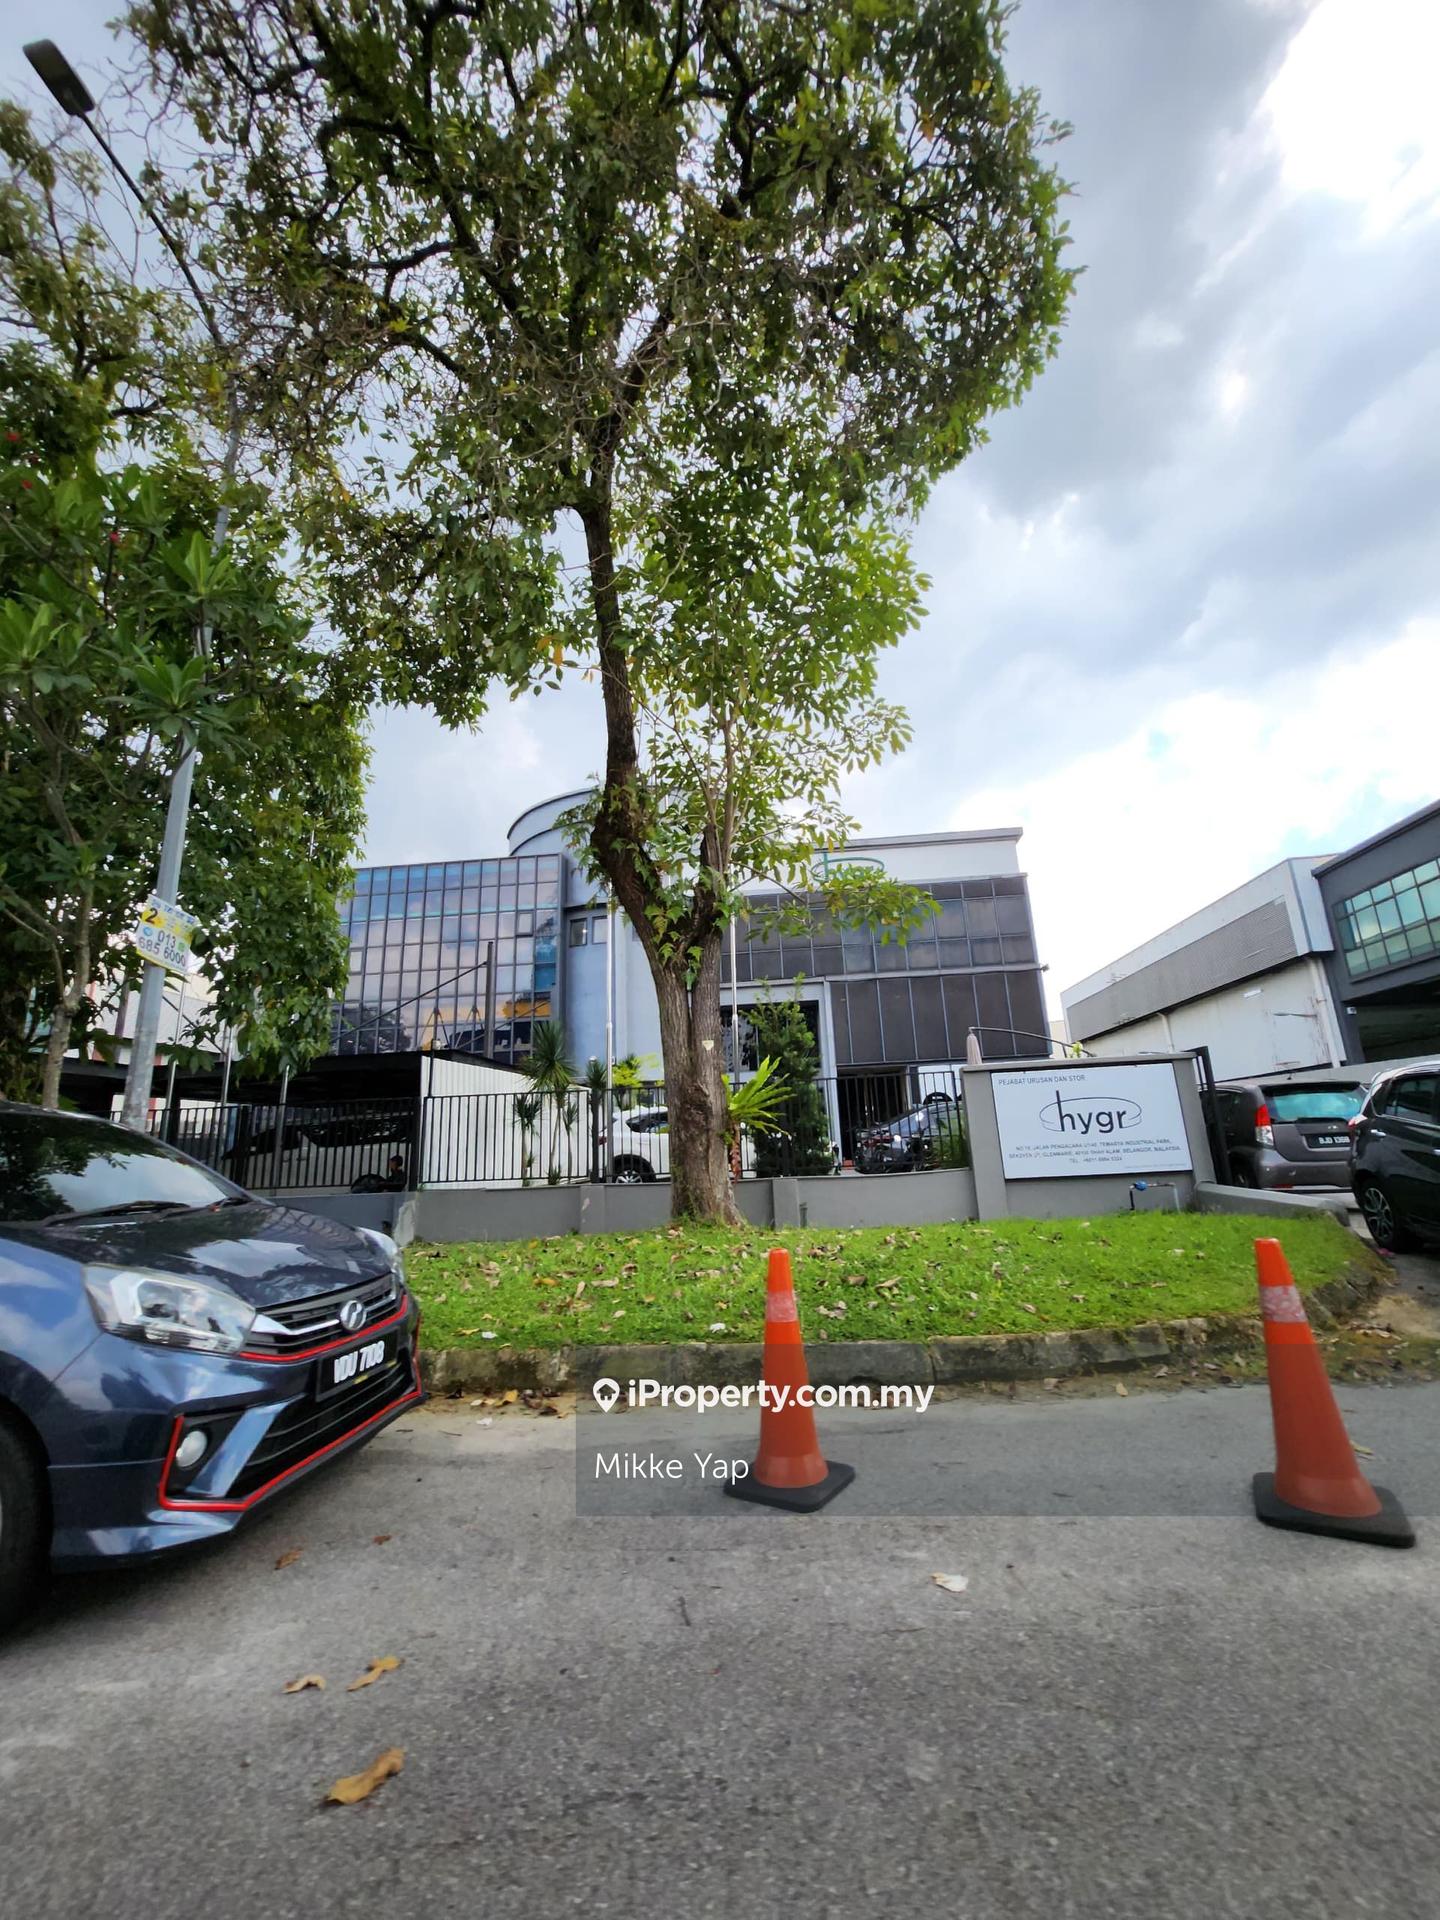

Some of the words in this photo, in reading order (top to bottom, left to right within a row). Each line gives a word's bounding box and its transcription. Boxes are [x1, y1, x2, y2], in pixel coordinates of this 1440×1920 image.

[139, 936, 160, 955] 685
[164, 946, 186, 967] 6000
[158, 930, 176, 949] 013
[998, 1078, 1026, 1086] PEJABAT
[1027, 1076, 1053, 1084] URUSAN
[1054, 1075, 1068, 1083] DAN
[1069, 1074, 1086, 1082] STOR
[1056, 1090, 1127, 1135] hygr
